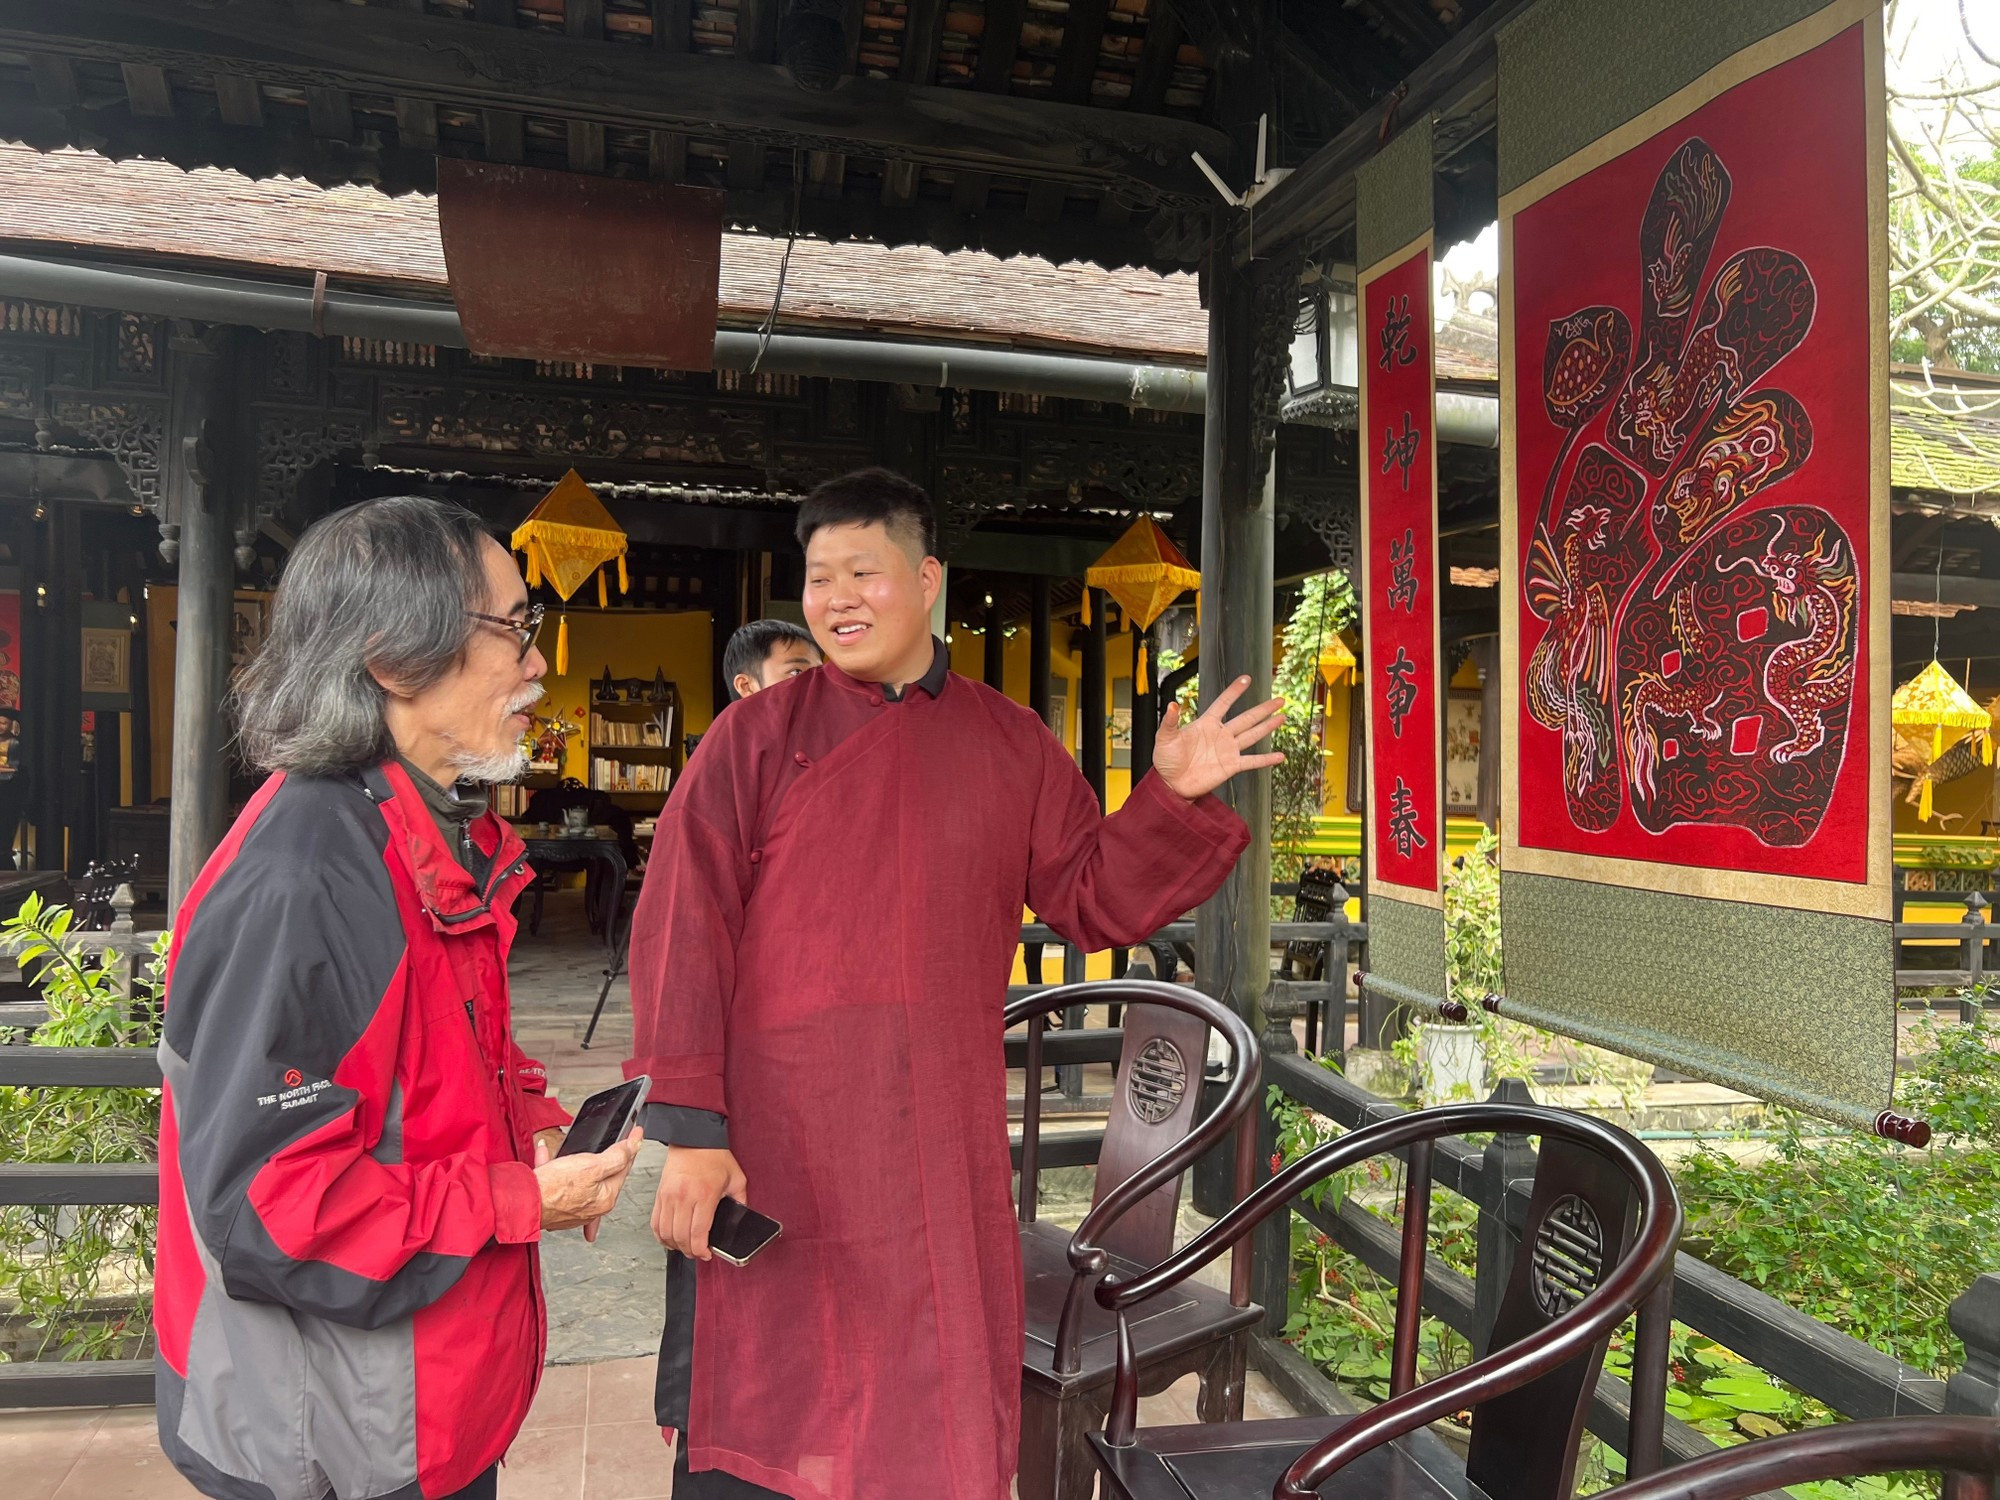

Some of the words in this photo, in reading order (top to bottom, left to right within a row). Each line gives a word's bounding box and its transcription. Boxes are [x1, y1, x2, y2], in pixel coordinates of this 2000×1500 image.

[257, 1094, 277, 1107] THE
[279, 1085, 311, 1102] NORTH
[281, 1093, 319, 1110] SUMMIT
